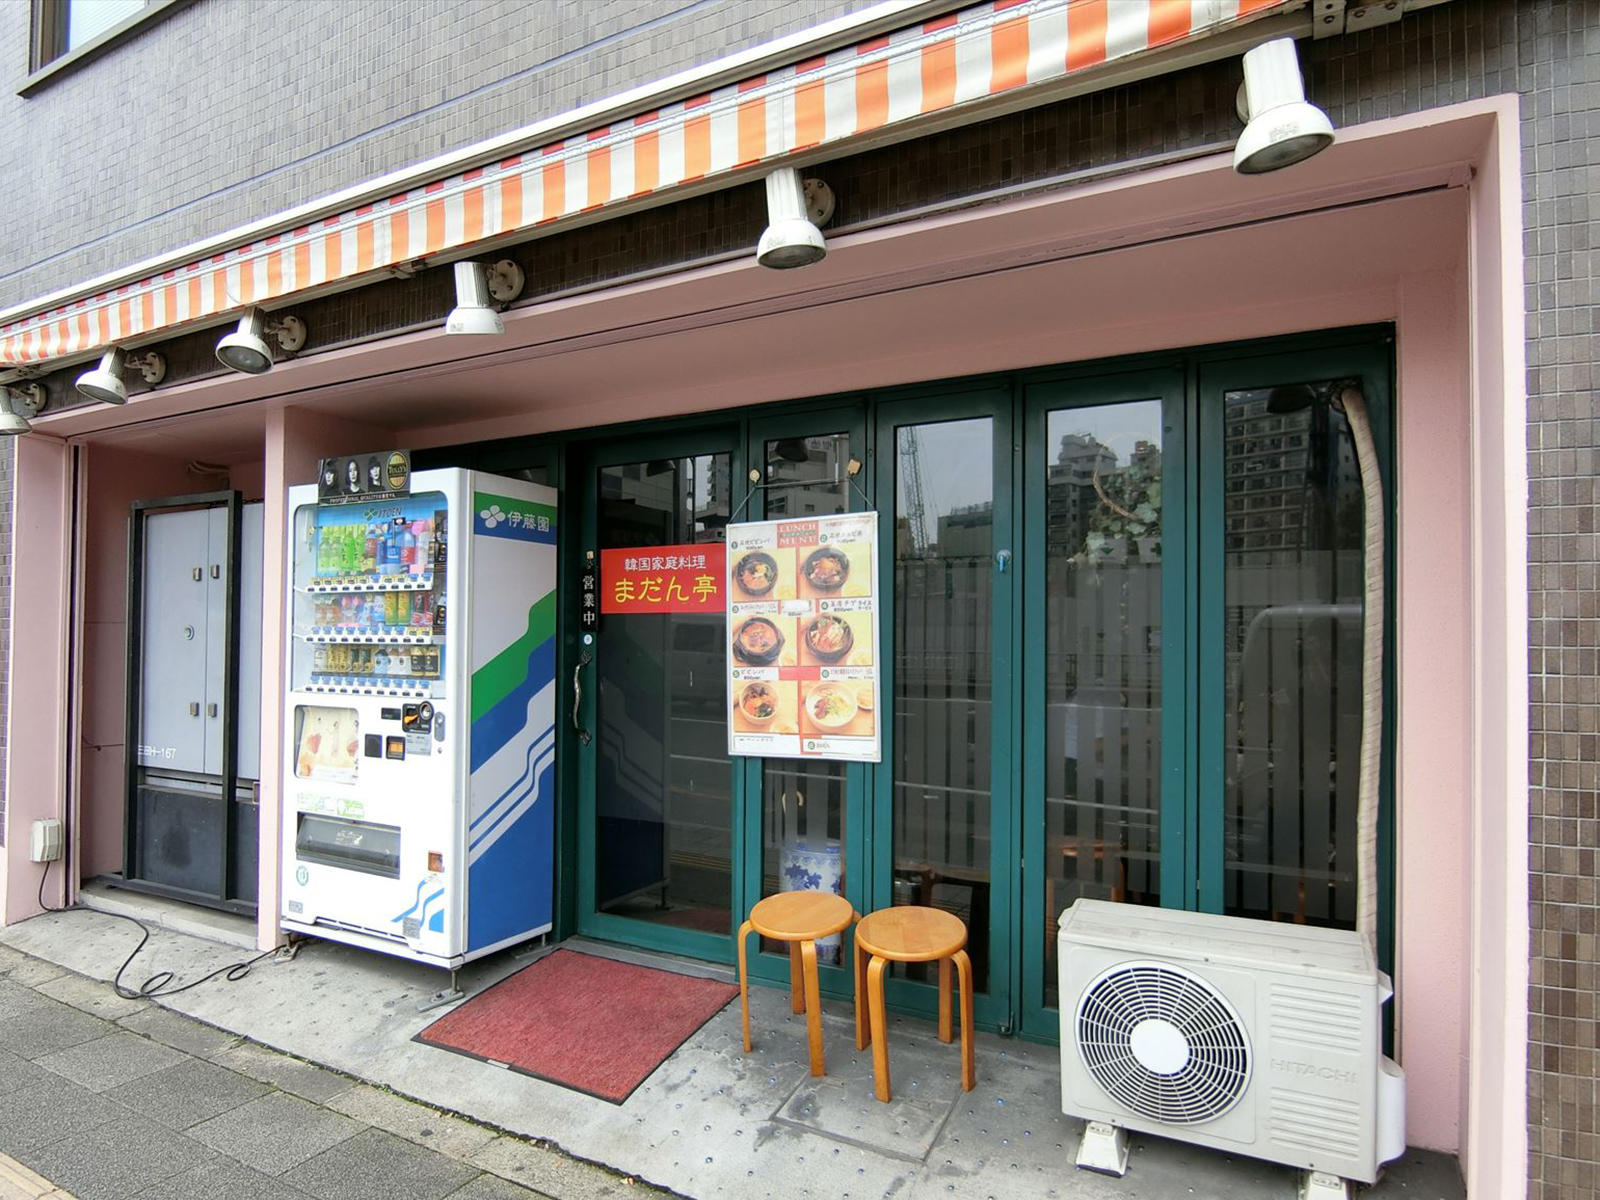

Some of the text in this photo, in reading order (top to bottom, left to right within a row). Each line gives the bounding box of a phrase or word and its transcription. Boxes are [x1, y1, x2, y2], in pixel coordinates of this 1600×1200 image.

[388, 464, 407, 475] TULLY'S
[507, 511, 550, 533] 伊藤園
[779, 523, 816, 533] LUNCH
[779, 536, 816, 545] MENU
[625, 555, 707, 571] 韓国家庭料理
[614, 574, 717, 603] まだん亭
[583, 575, 595, 626] 営業中
[1269, 1058, 1358, 1085] HITACHI
